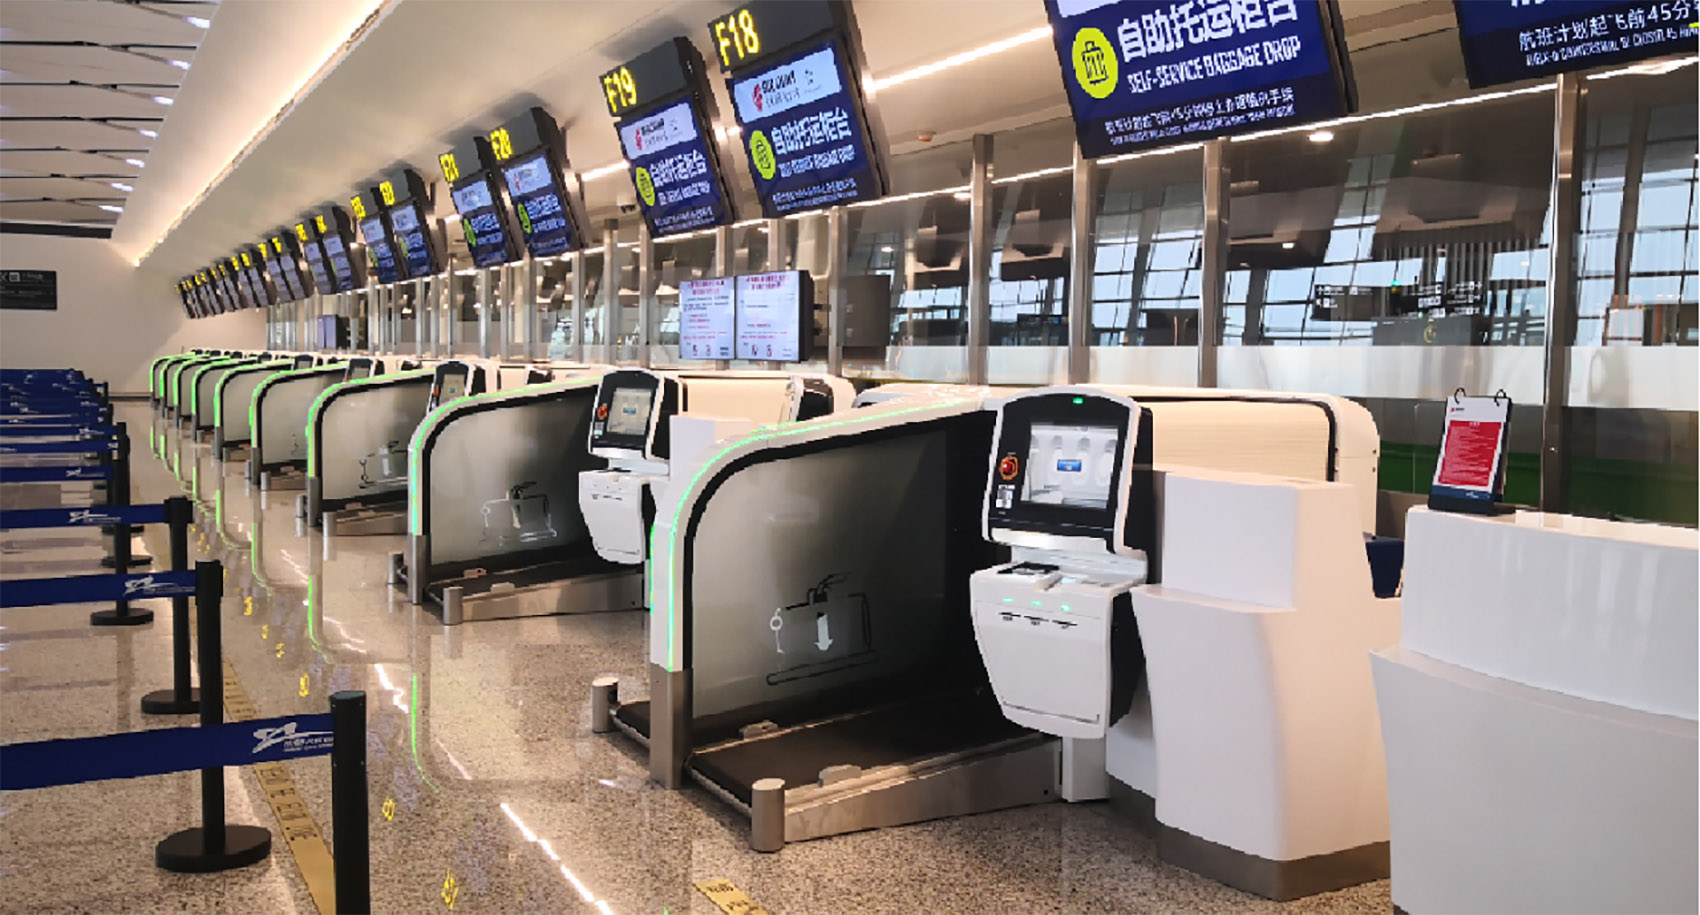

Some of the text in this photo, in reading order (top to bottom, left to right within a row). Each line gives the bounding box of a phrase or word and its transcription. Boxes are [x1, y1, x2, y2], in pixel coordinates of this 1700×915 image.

[715, 9, 760, 66] F18
[1519, 0, 1699, 51] 航班计划起飞前45分
[604, 66, 637, 112] F19
[1127, 35, 1301, 93] SELF-SERVICE BAGGAGE DROP
